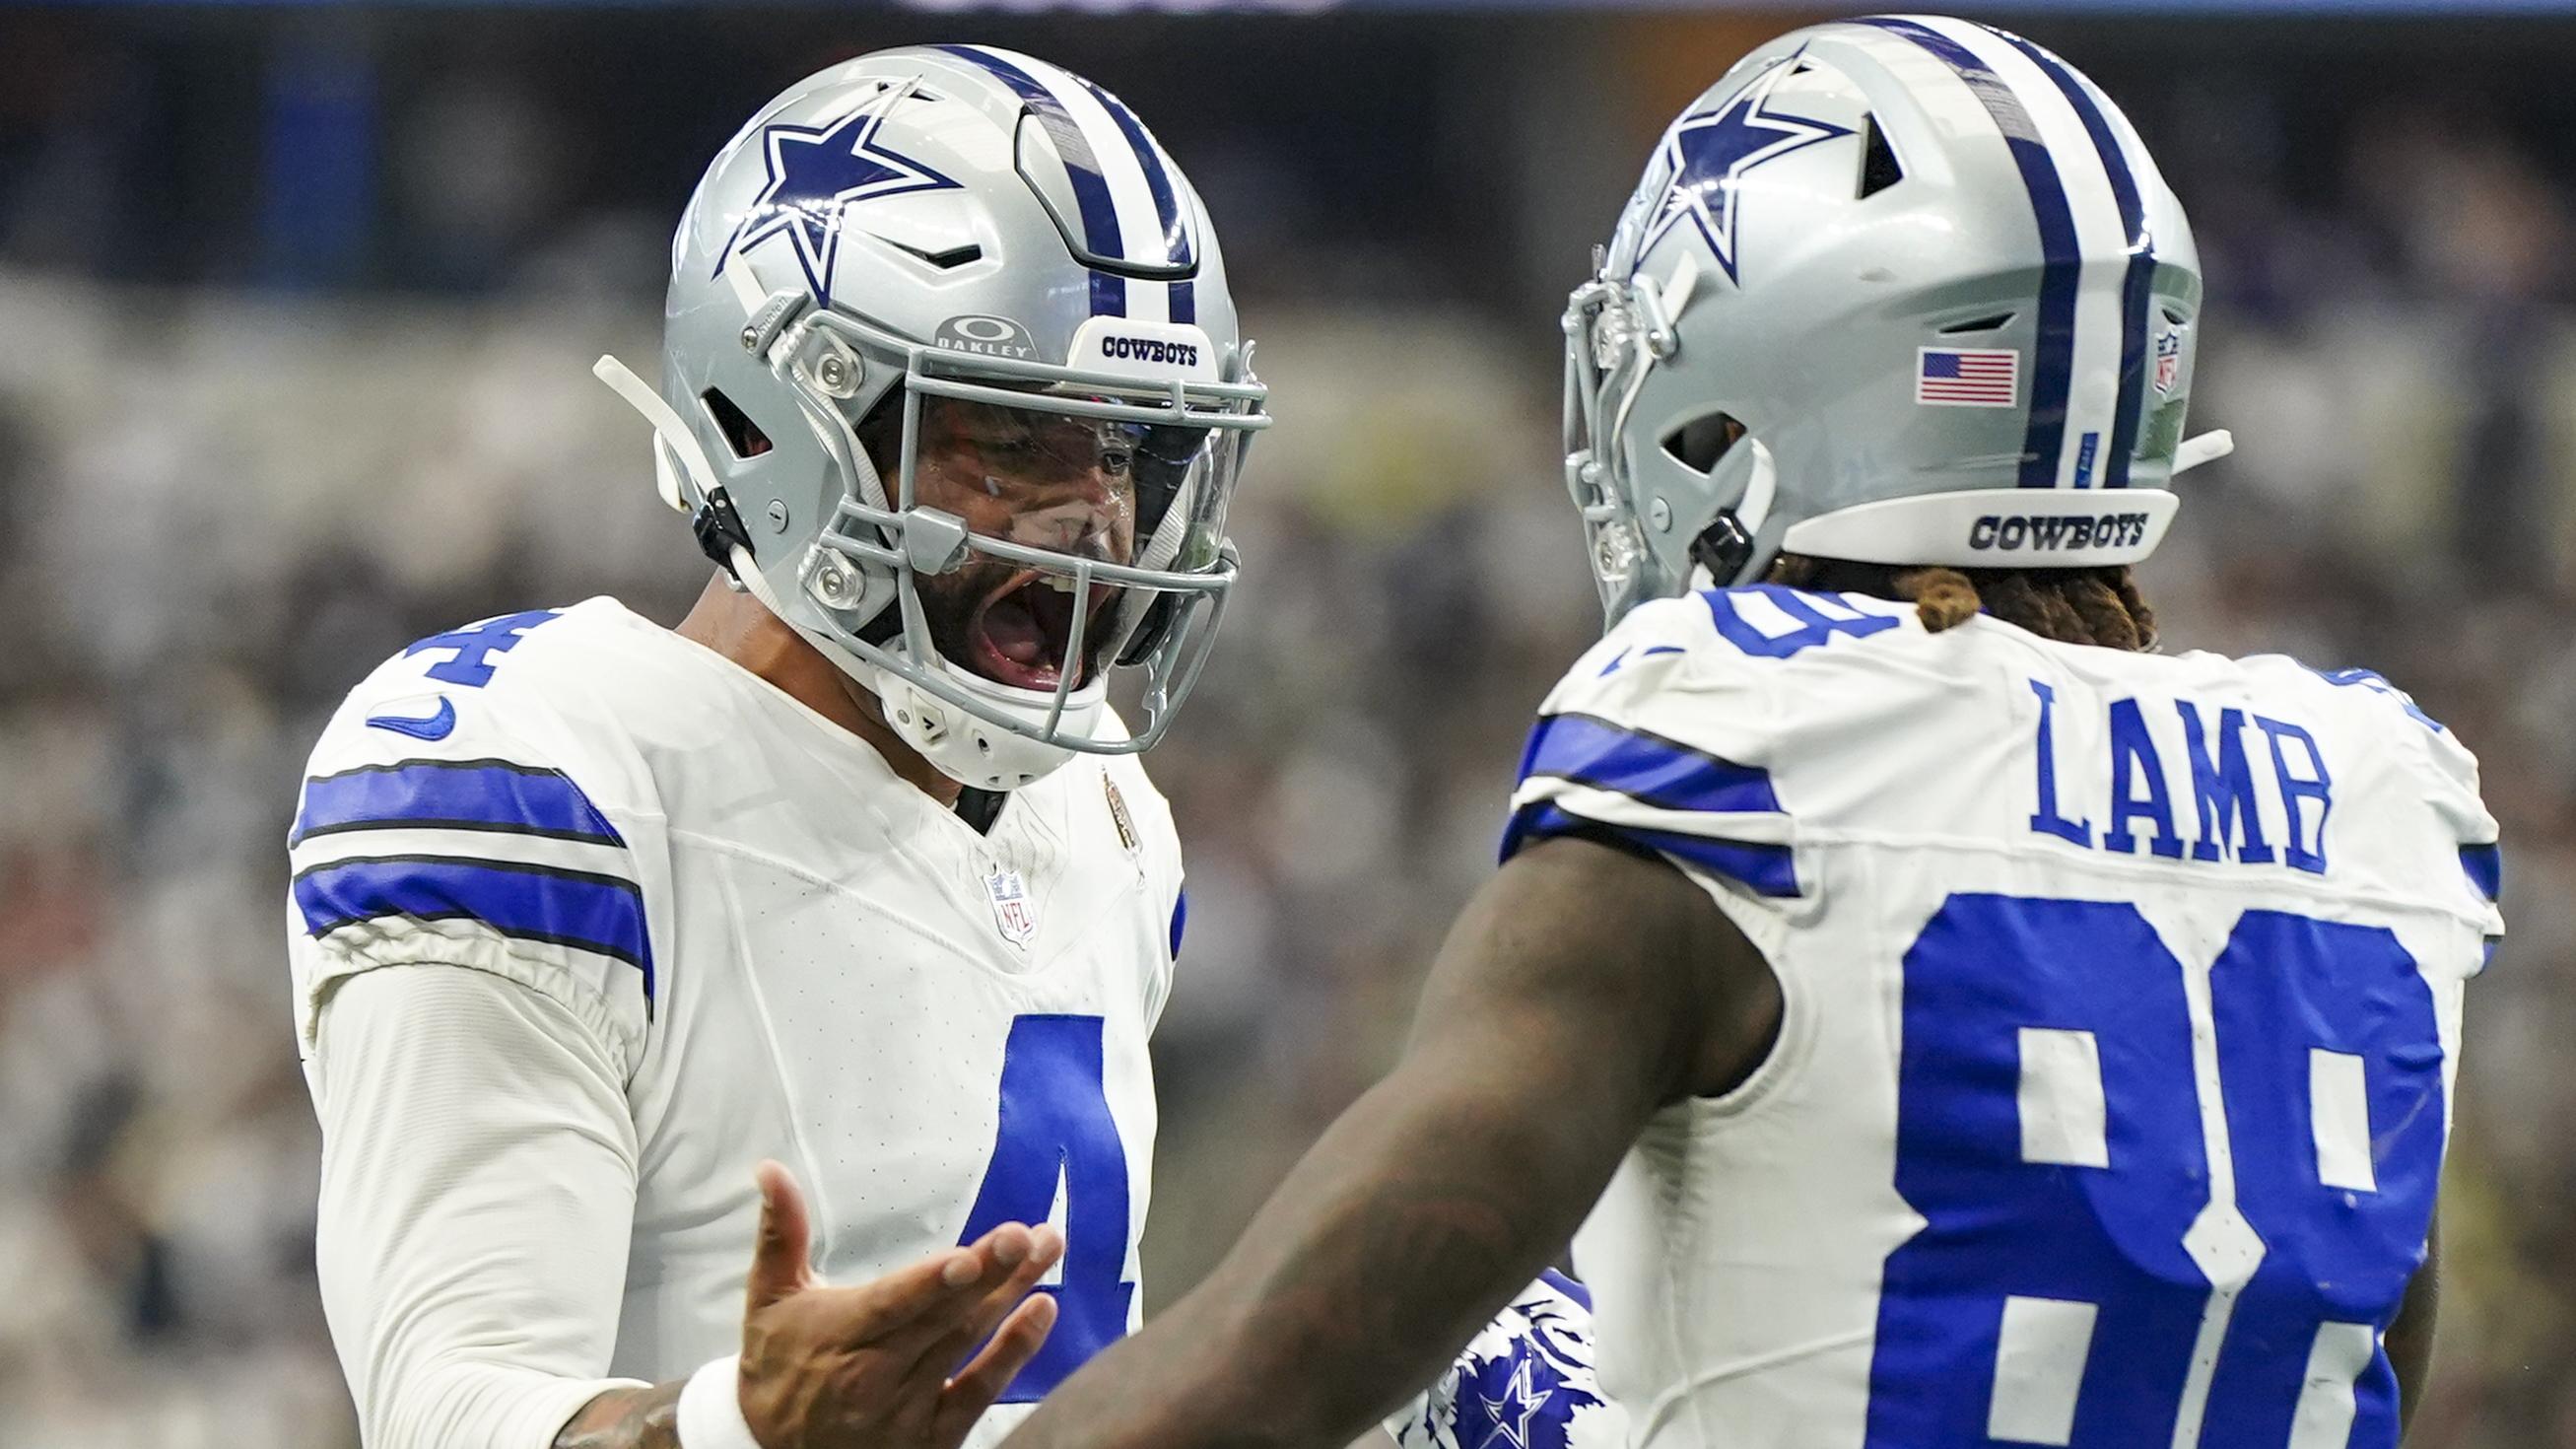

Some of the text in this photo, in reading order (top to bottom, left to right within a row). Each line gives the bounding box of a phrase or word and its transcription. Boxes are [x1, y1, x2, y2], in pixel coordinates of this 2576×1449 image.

[937, 337, 1027, 358] OAKLEY
[1102, 336, 1197, 367] COWBOYS
[1969, 513, 2149, 551] COWBOYS
[402, 609, 565, 688] 4
[2028, 677, 2332, 875] LAMB
[1001, 901, 1031, 932] NFL
[1864, 893, 2446, 1449] 88
[956, 1014, 1135, 1405] 4
